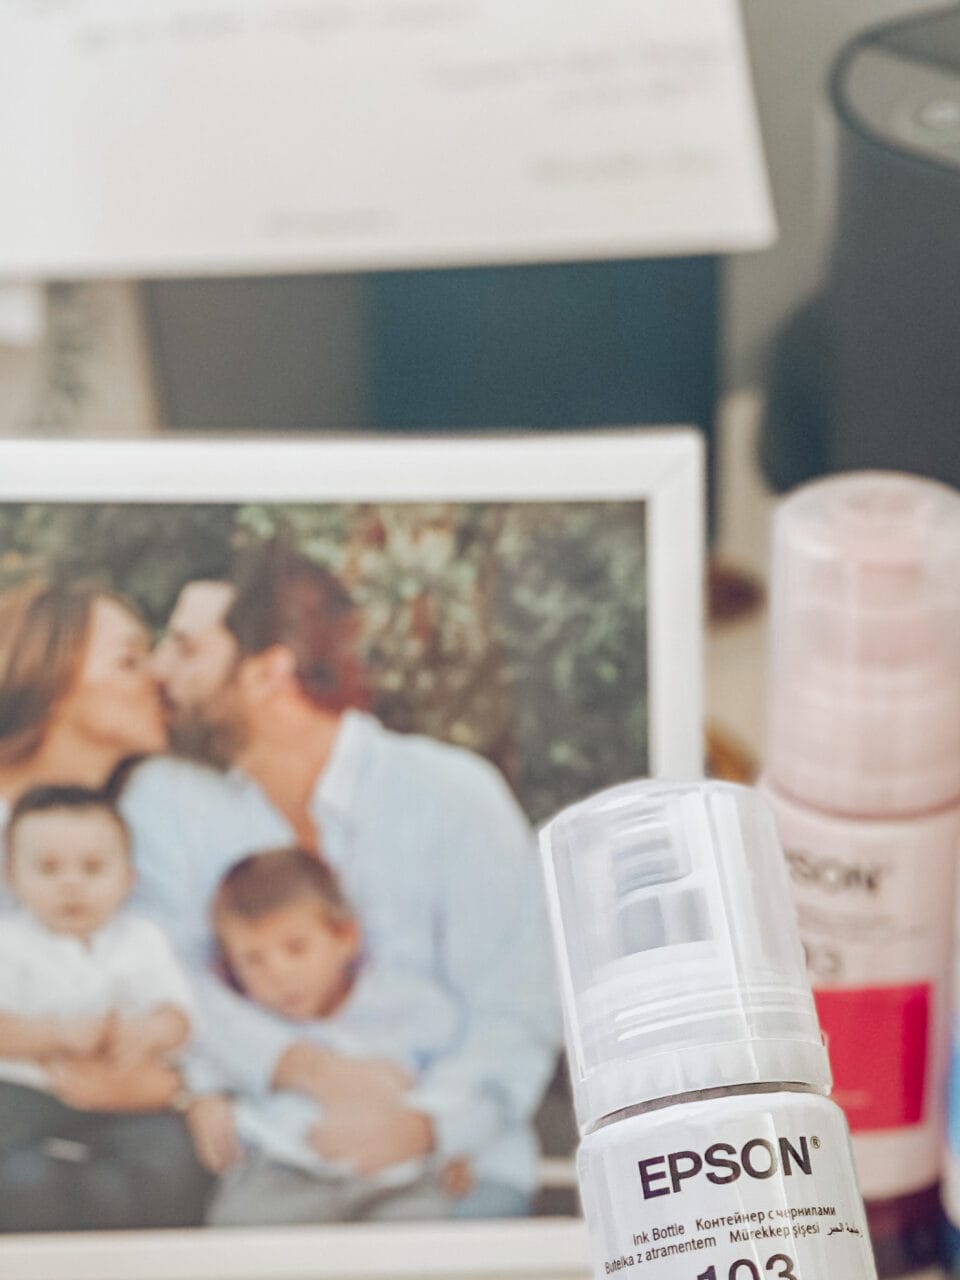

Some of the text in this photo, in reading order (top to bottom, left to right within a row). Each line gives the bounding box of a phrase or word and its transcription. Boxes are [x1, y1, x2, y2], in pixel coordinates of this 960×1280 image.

[784, 848, 882, 897] SON
[695, 1211, 766, 1232] Контейнер
[633, 1223, 685, 1246] Ink Bottle
[729, 1223, 790, 1244] Mürekkep
[604, 1236, 717, 1275] Butelka z atramentem
